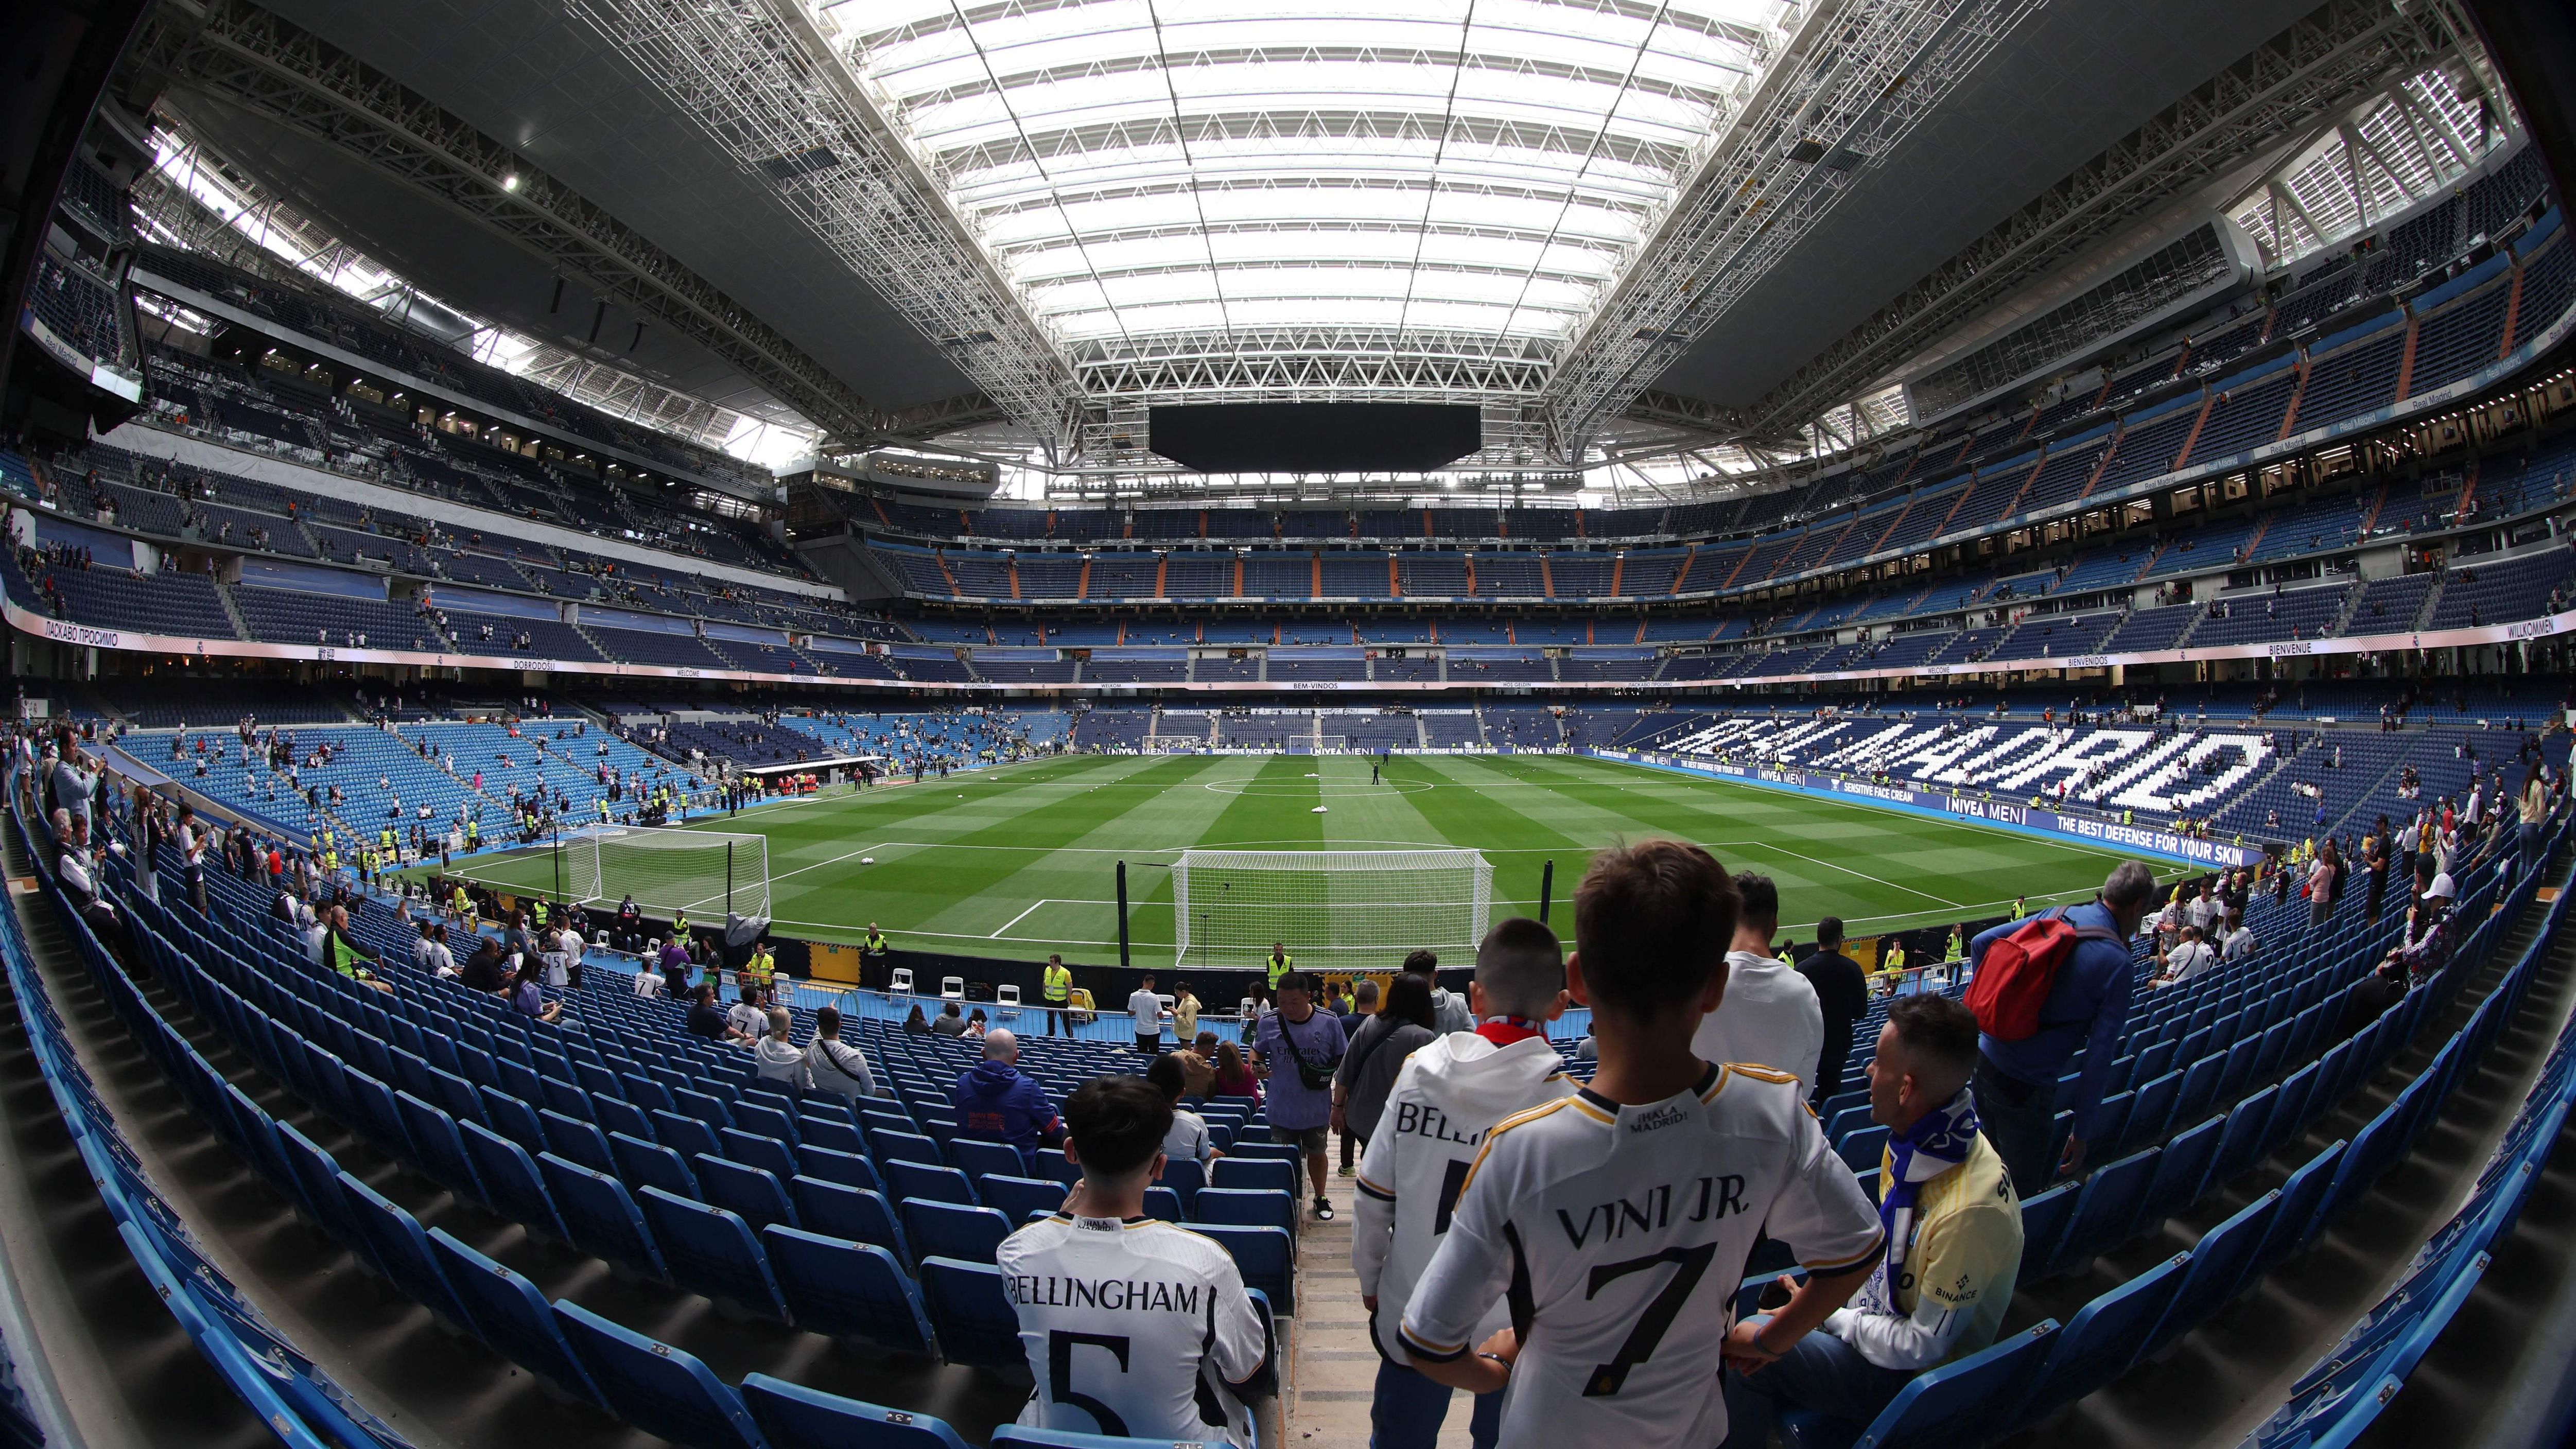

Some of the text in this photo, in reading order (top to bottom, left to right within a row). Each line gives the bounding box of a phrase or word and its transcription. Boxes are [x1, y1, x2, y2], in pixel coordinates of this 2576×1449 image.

[45, 335, 78, 366] Real Madrid
[2486, 355, 2521, 380] Real Madrid
[2413, 390, 2451, 410] Real Madrid
[2339, 413, 2376, 432] Real Madrid
[2270, 439, 2305, 454] Real Madrid
[2219, 457, 2238, 468] Madrid
[2145, 476, 2175, 490] Real Madrid
[2101, 491, 2117, 501] Madrid
[46, 621, 118, 647] ЛАСКАВО ПРОСИМО
[2508, 619, 2554, 639] WILLKOMMEN
[2269, 642, 2311, 655] BIENVENUE
[515, 660, 555, 670] DOBRODOŠLI
[2068, 656, 2108, 667] BIENVENIDOS
[1927, 666, 1950, 674] WELCOME
[1643, 755, 1668, 766] NIVEA MEN
[1698, 762, 1713, 771] DEFENSE
[1714, 764, 1722, 773] FOR
[1722, 765, 1734, 774] YOUR
[1734, 767, 1744, 775] SKIN
[1761, 770, 1800, 785] NIVEA MEN
[1844, 783, 1913, 803] SENSITIVE FACE CREAM
[1952, 798, 2020, 824] NIVEA MEN
[2057, 816, 2243, 867] THE BEST DEFENSE FOR YOUR SKIN
[554, 956, 560, 968] 5
[638, 981, 646, 994] 7
[736, 1019, 748, 1034] 7
[1629, 1111, 1689, 1134] MADRID!
[1557, 1175, 1750, 1250] VINI JR.
[1004, 1276, 1198, 1315] BELLINGHAM
[1936, 1287, 1977, 1303] BINANCE
[1582, 1242, 1718, 1396] 7
[1049, 1329, 1131, 1437] 5
